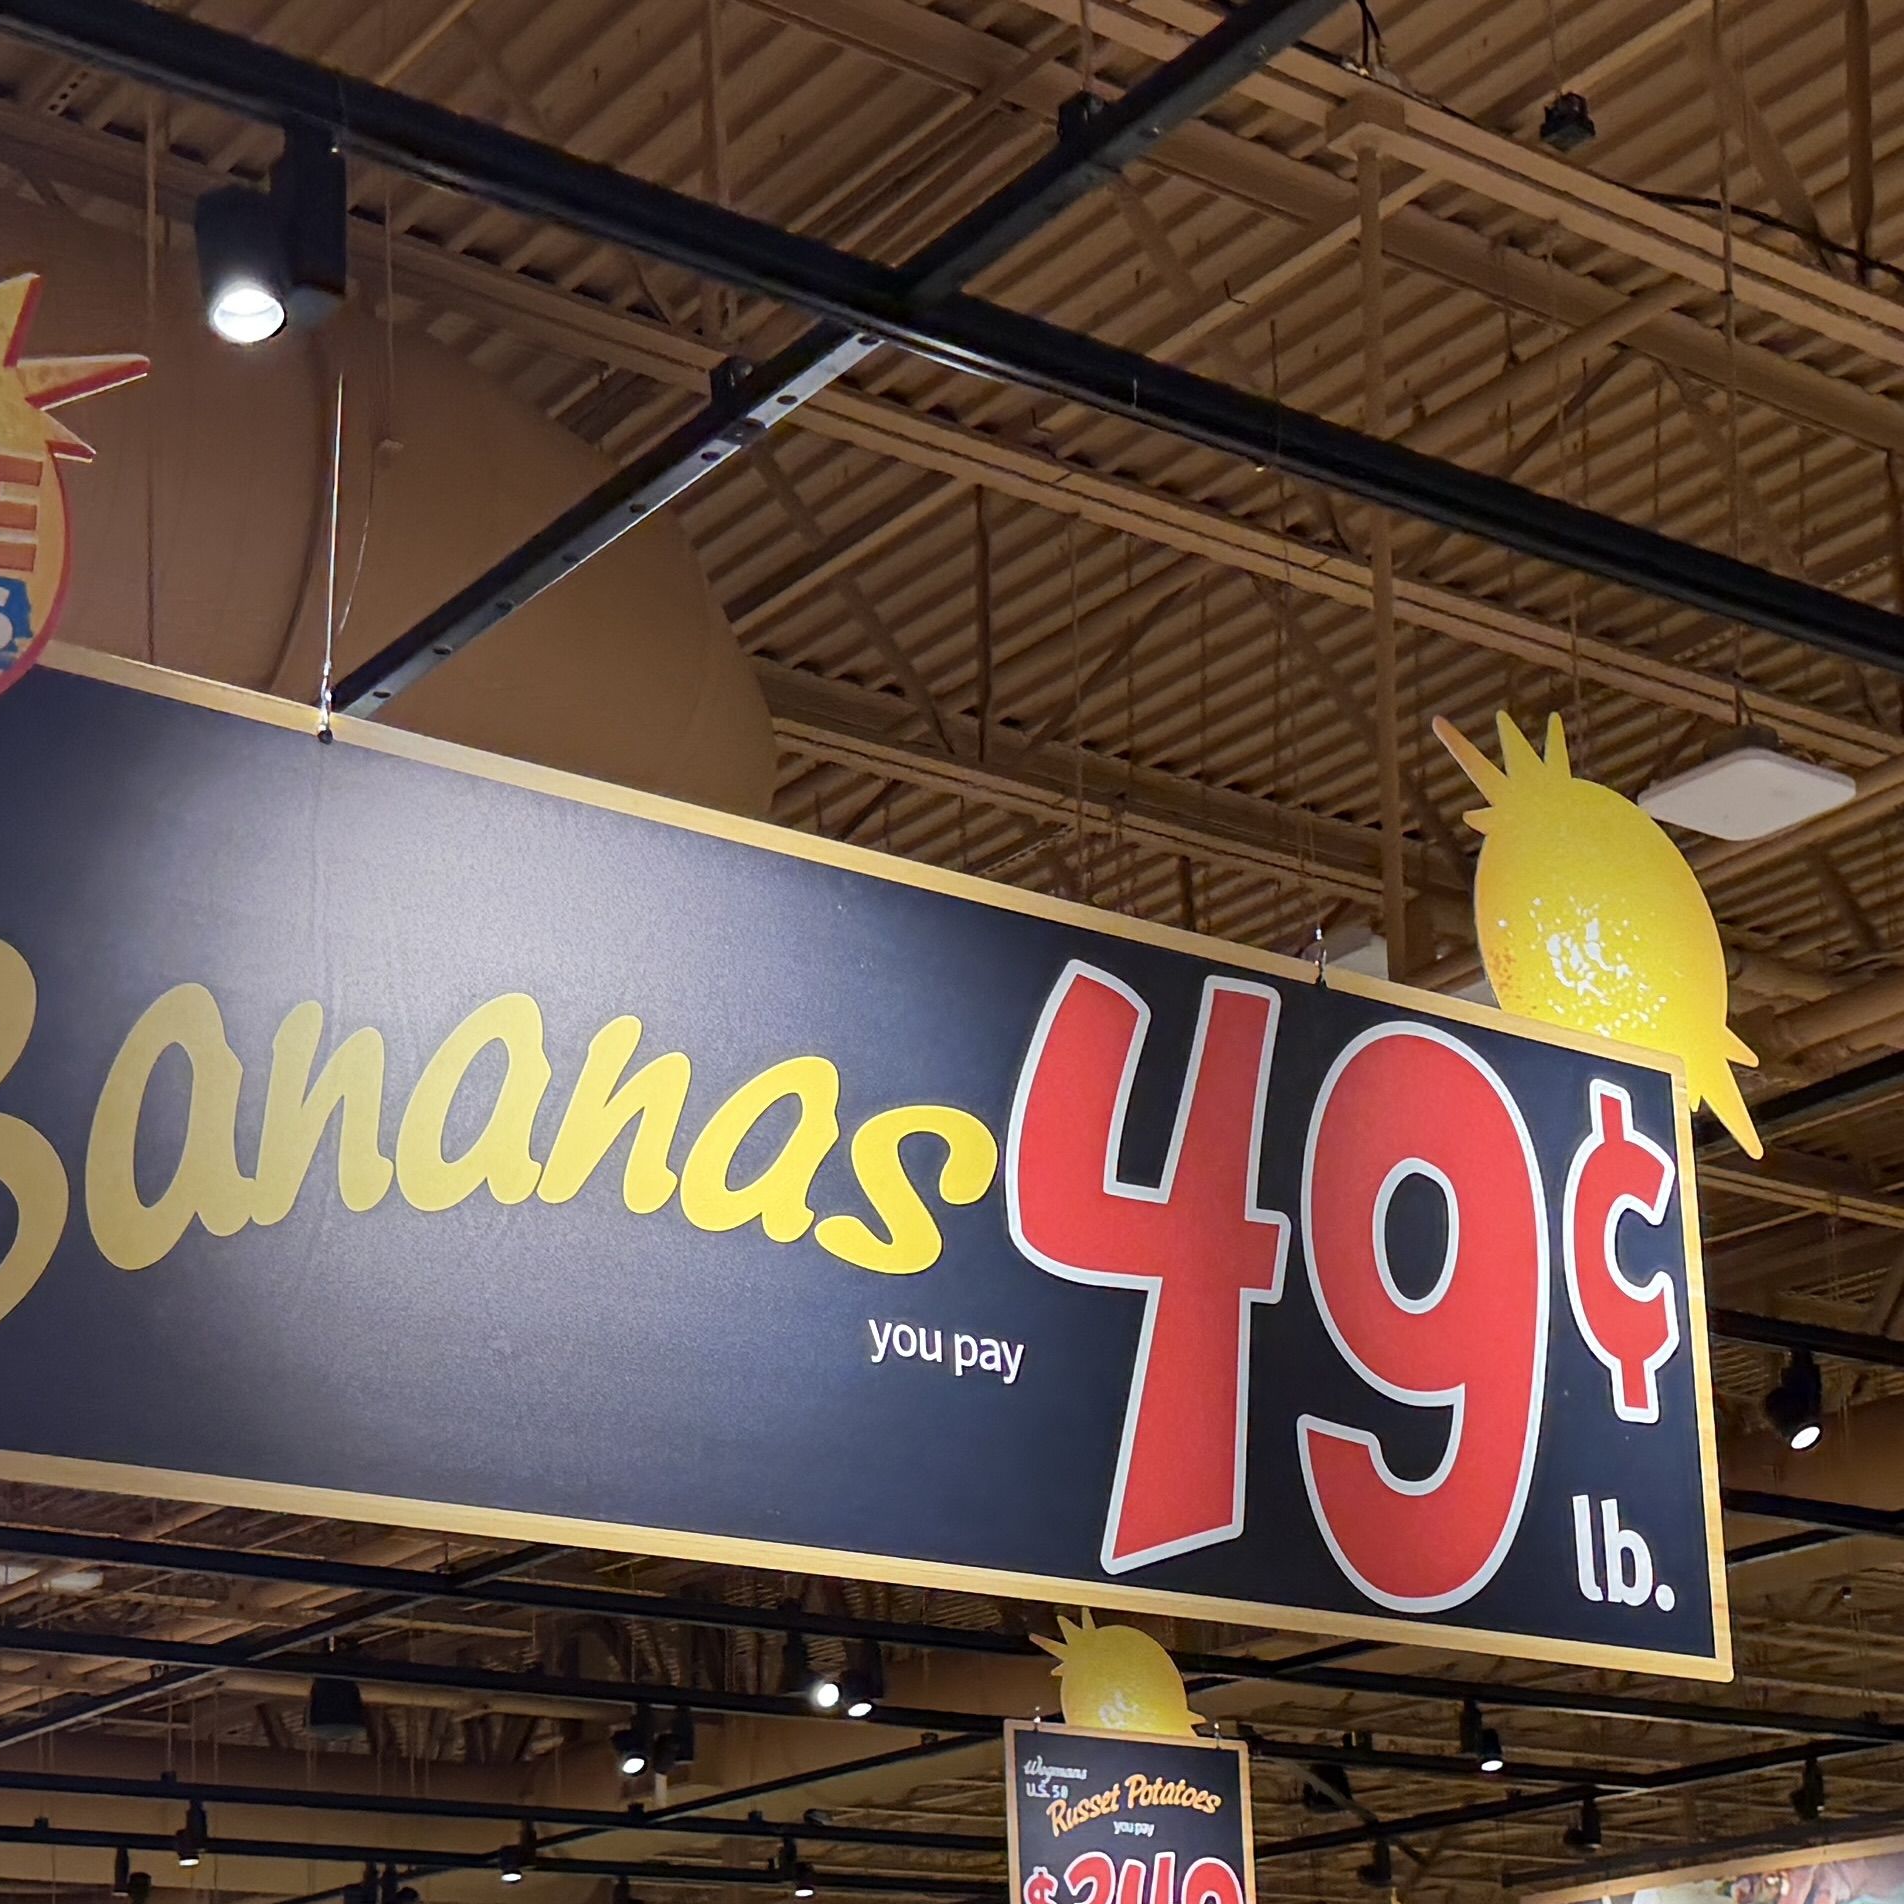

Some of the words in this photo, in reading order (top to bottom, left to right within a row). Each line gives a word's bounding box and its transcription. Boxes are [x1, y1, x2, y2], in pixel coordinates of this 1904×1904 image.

[1008, 958, 1680, 1613] 49¢
[868, 1317, 943, 1364] you
[954, 1331, 1025, 1385] pay
[1572, 1494, 1676, 1612] lb.
[1046, 1782, 1121, 1838] Russet
[1124, 1773, 1223, 1815] Potatoes
[1113, 1820, 1133, 1836] you
[1134, 1821, 1156, 1838] pay
